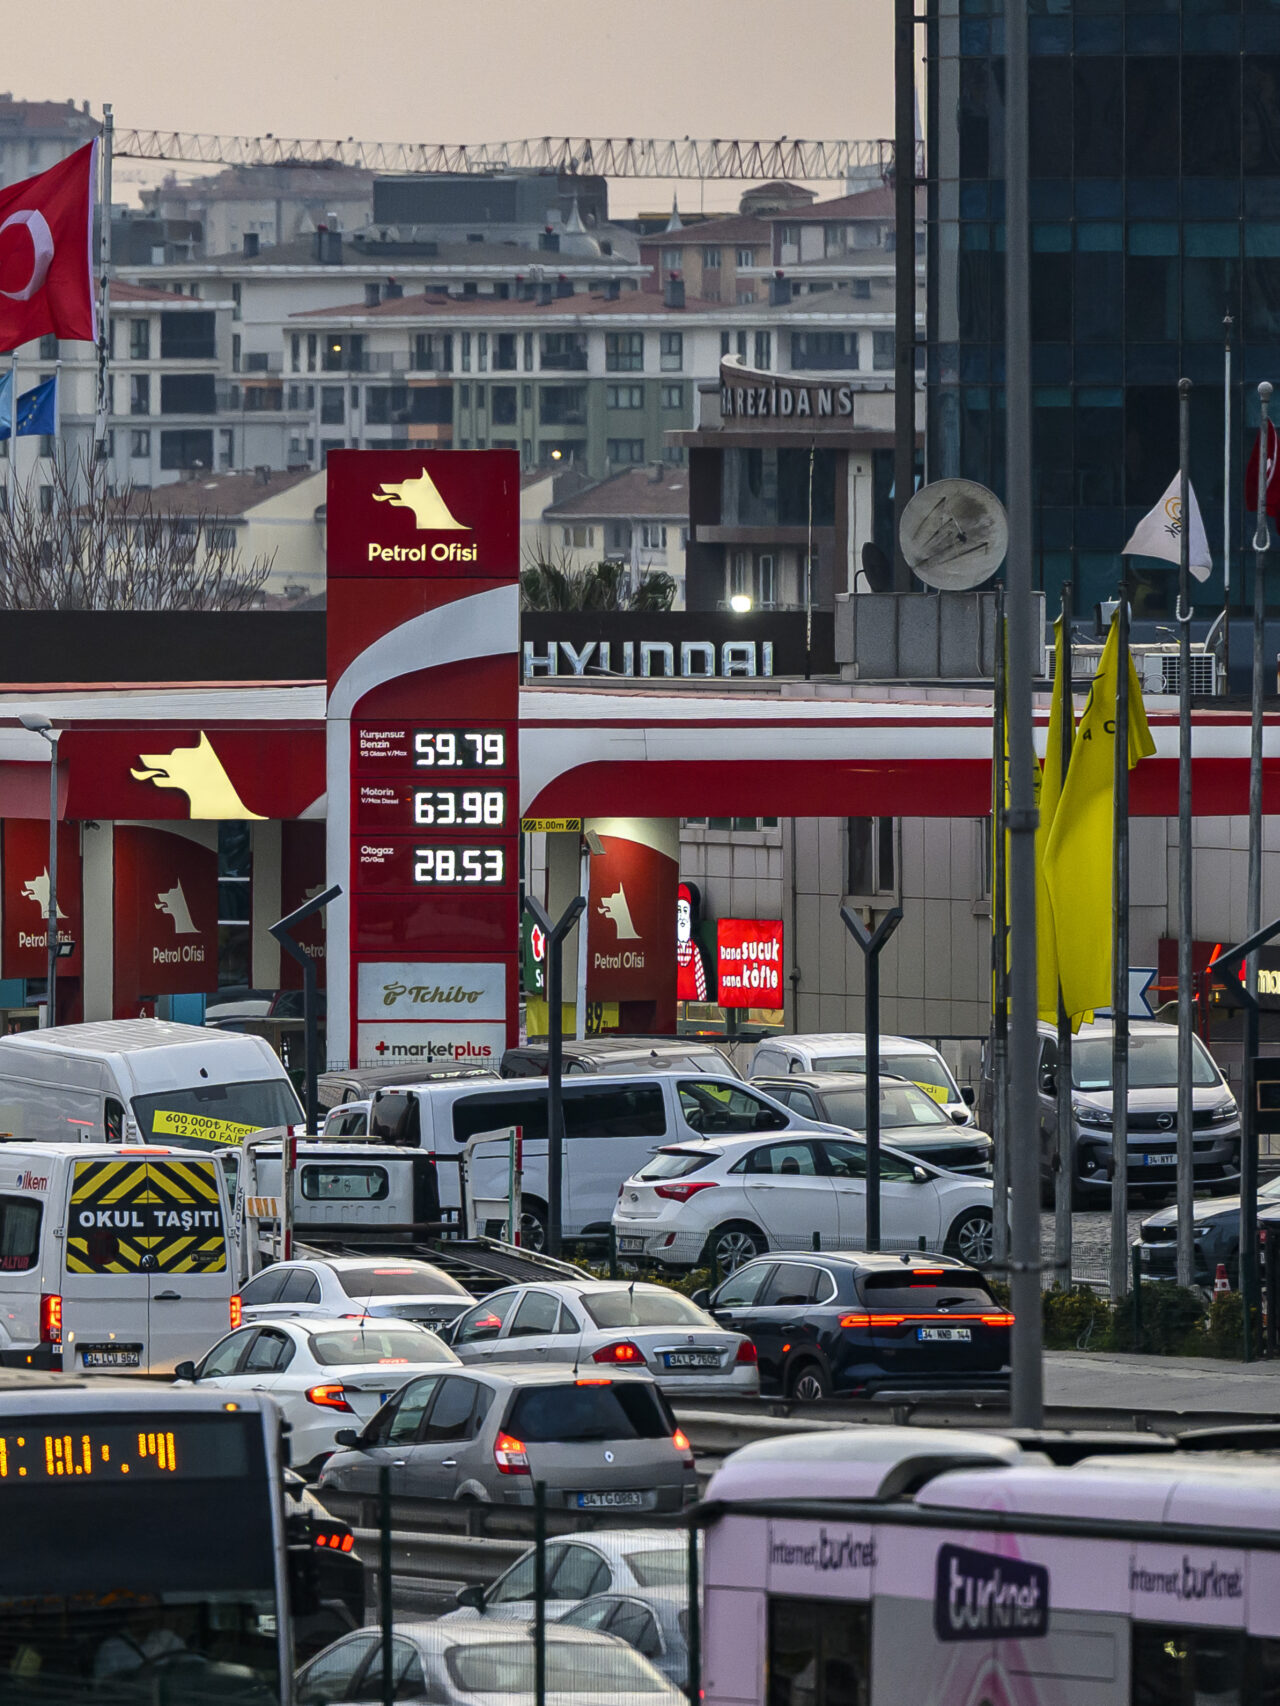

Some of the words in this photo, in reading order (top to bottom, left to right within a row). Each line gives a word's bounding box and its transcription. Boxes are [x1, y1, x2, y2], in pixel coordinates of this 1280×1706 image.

[368, 543, 426, 561] Petrol
[430, 543, 477, 561] Ofisi
[523, 641, 773, 677] HYUNDAI
[360, 740, 390, 748] Benzin
[360, 730, 405, 740] Kurşunsuz
[415, 733, 504, 766] 59.79
[361, 787, 394, 796] Motorin
[415, 792, 504, 824] 63.98
[537, 821, 564, 830] 5.00m
[361, 846, 394, 856] Otogaz
[415, 850, 503, 881] 28.53
[19, 931, 47, 948] Petrol
[152, 947, 181, 964] Petrol
[182, 945, 205, 962] Ofisi
[720, 945, 741, 960] bana
[741, 938, 780, 961] sucuk
[594, 953, 621, 969] Petrol
[623, 951, 645, 968] Ofisi
[722, 975, 741, 988] sana
[742, 962, 778, 989] köfte
[408, 985, 485, 1003] Tchibo
[392, 1041, 492, 1060] marketplus
[175, 1125, 188, 1133] 12
[190, 1128, 207, 1137] AY
[208, 1130, 217, 1139] 0
[79, 1211, 144, 1227] OKUL
[154, 1211, 220, 1231] TAŞITI
[88, 1353, 99, 1363] 34
[102, 1353, 118, 1363] LCU
[121, 1353, 137, 1363] 962
[670, 1354, 682, 1365] 34
[683, 1354, 696, 1365] LP
[949, 1556, 1041, 1631] turknet
